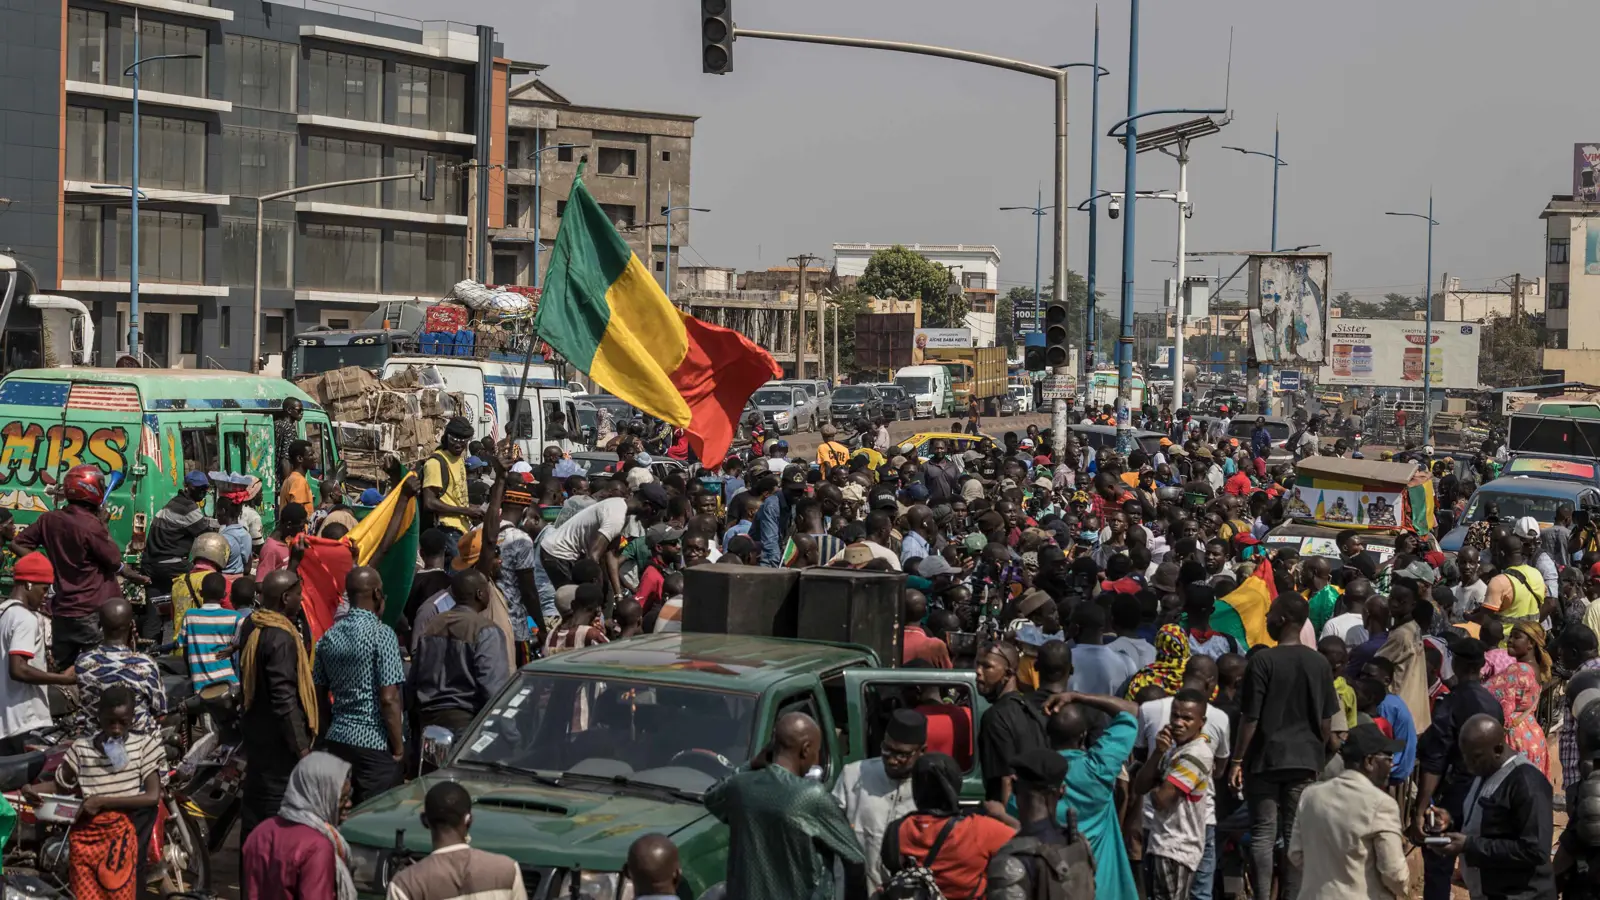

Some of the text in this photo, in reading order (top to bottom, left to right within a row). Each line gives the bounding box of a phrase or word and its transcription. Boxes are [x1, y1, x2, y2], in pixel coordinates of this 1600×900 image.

[1335, 324, 1367, 332] Sister
[1411, 336, 1435, 344] NOUVEU
[0, 421, 129, 491] MBS
